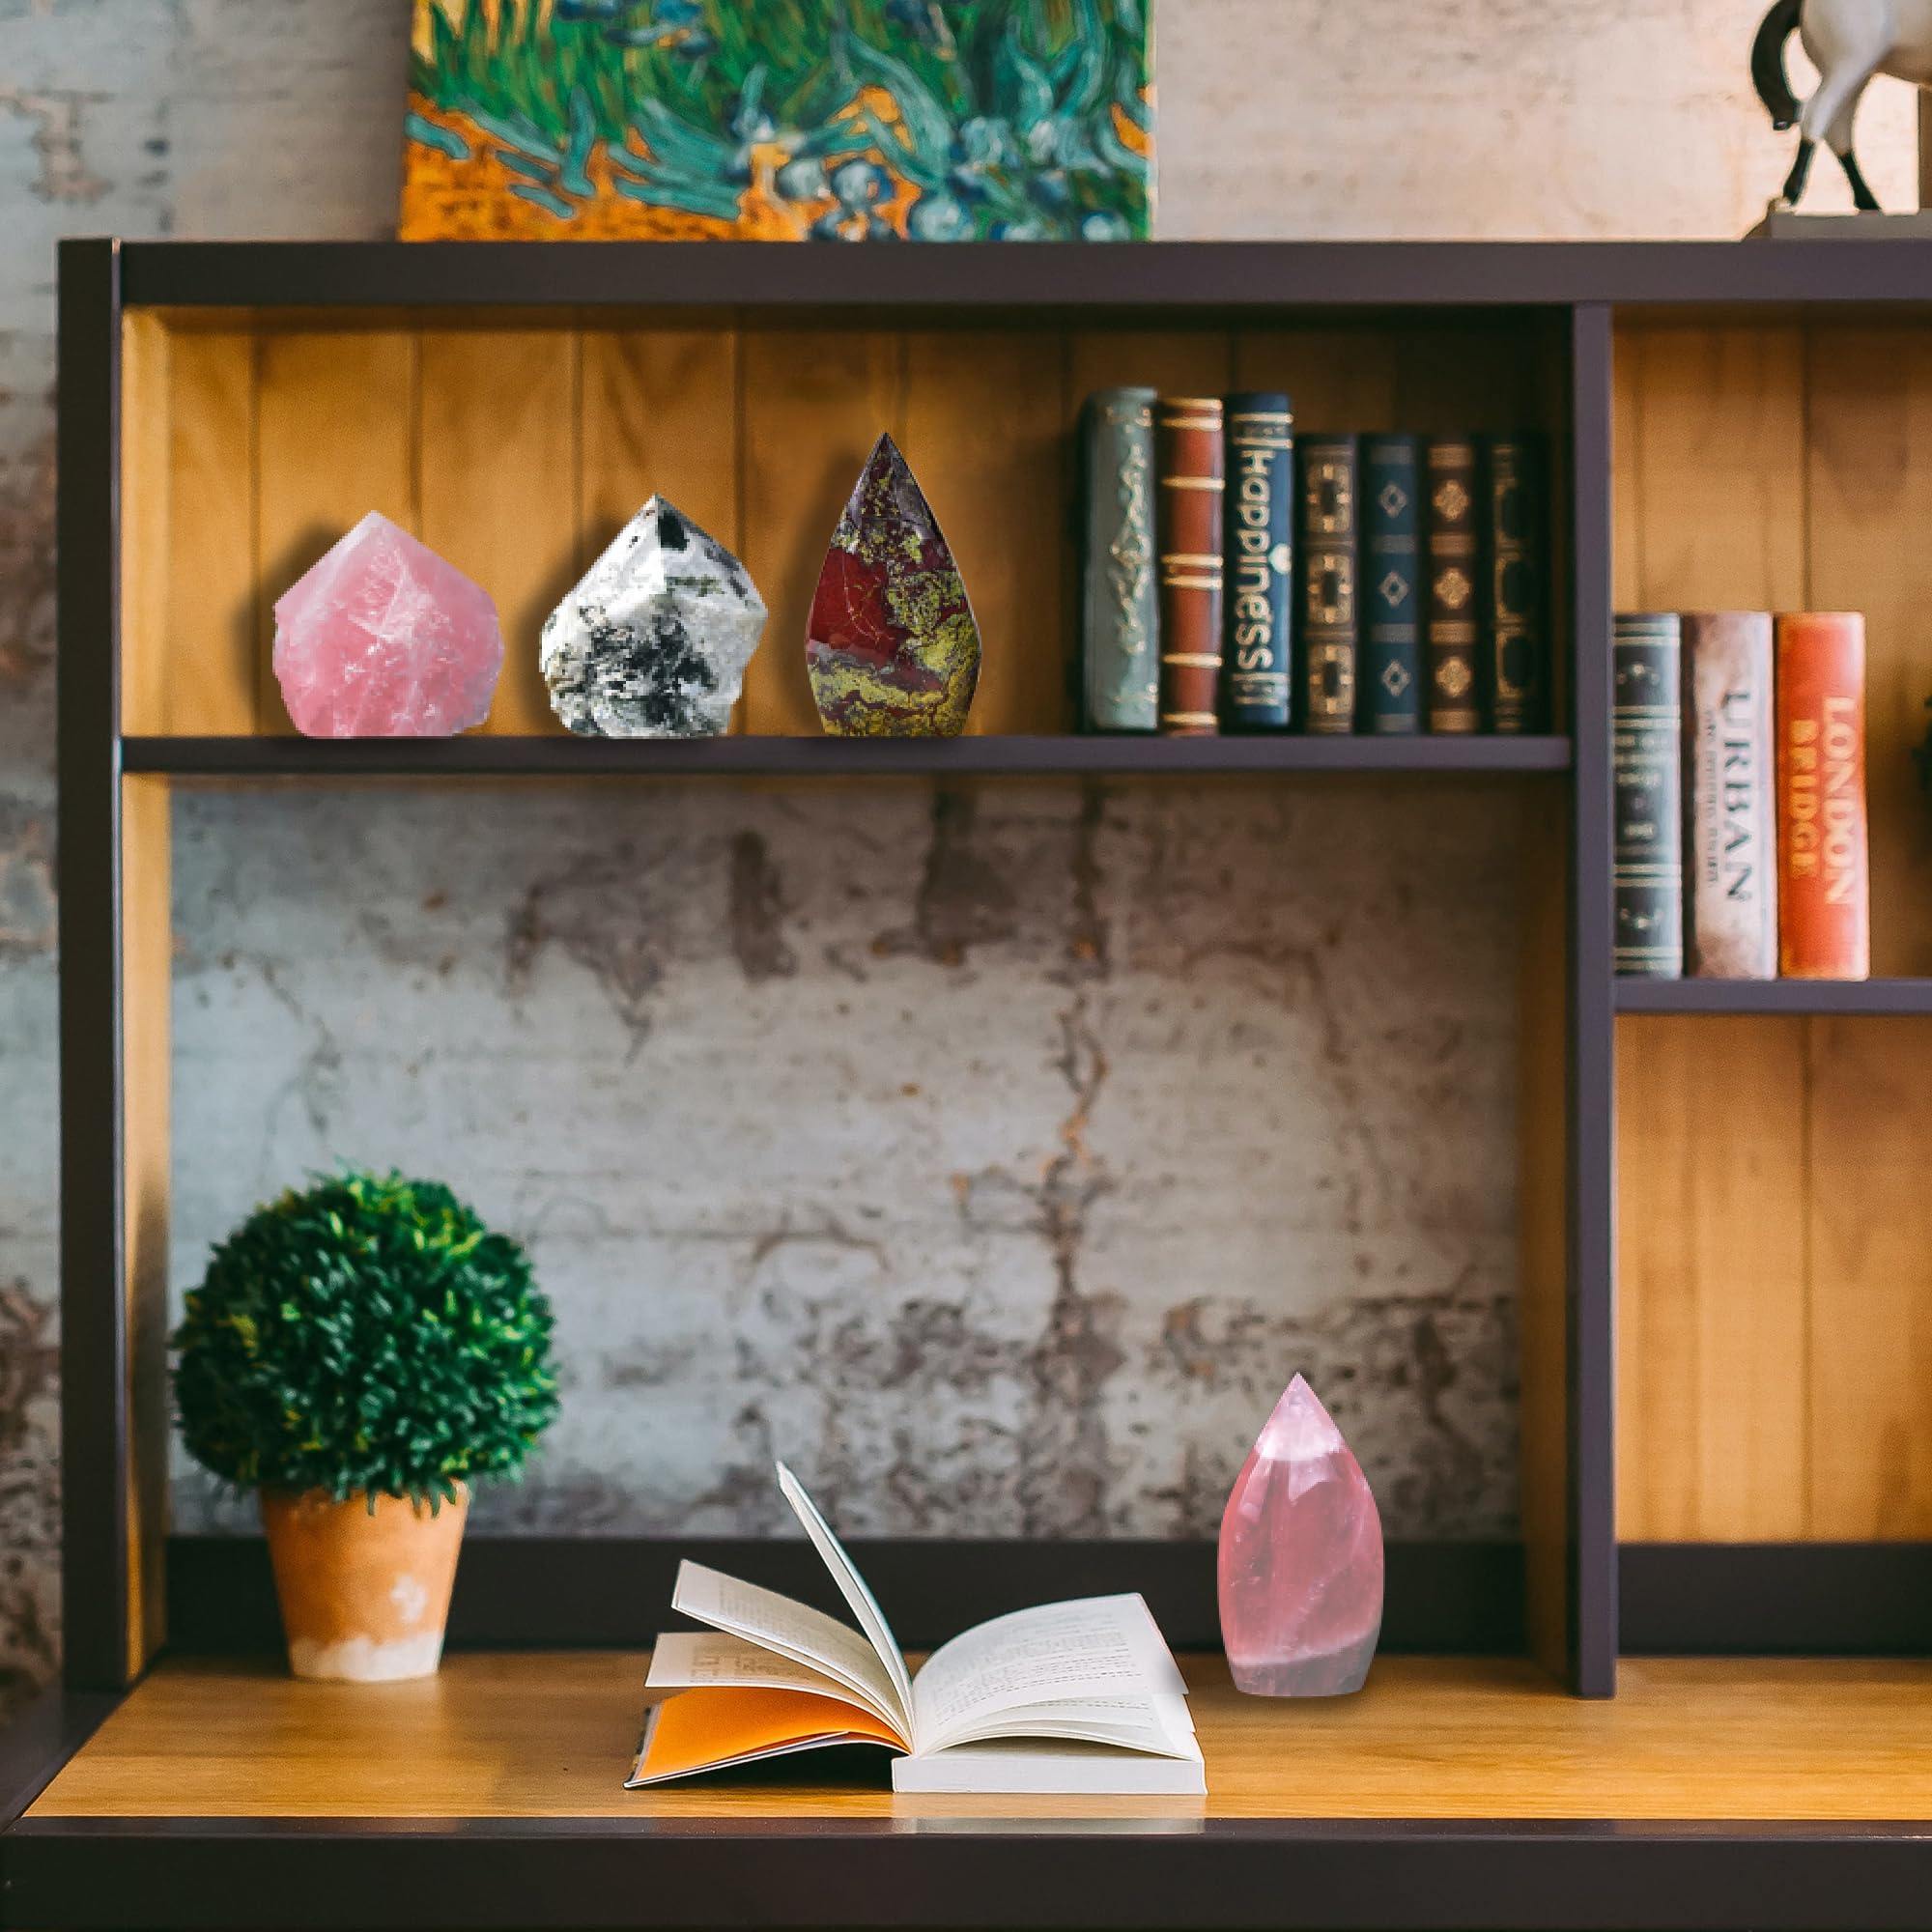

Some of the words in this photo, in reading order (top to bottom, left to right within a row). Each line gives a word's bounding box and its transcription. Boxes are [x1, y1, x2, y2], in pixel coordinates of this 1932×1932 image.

[1236, 449, 1293, 670] Happiness
[1722, 689, 1753, 901] URBAN
[1789, 719, 1820, 879] BRIDGE
[1823, 696, 1856, 905] LONDON
